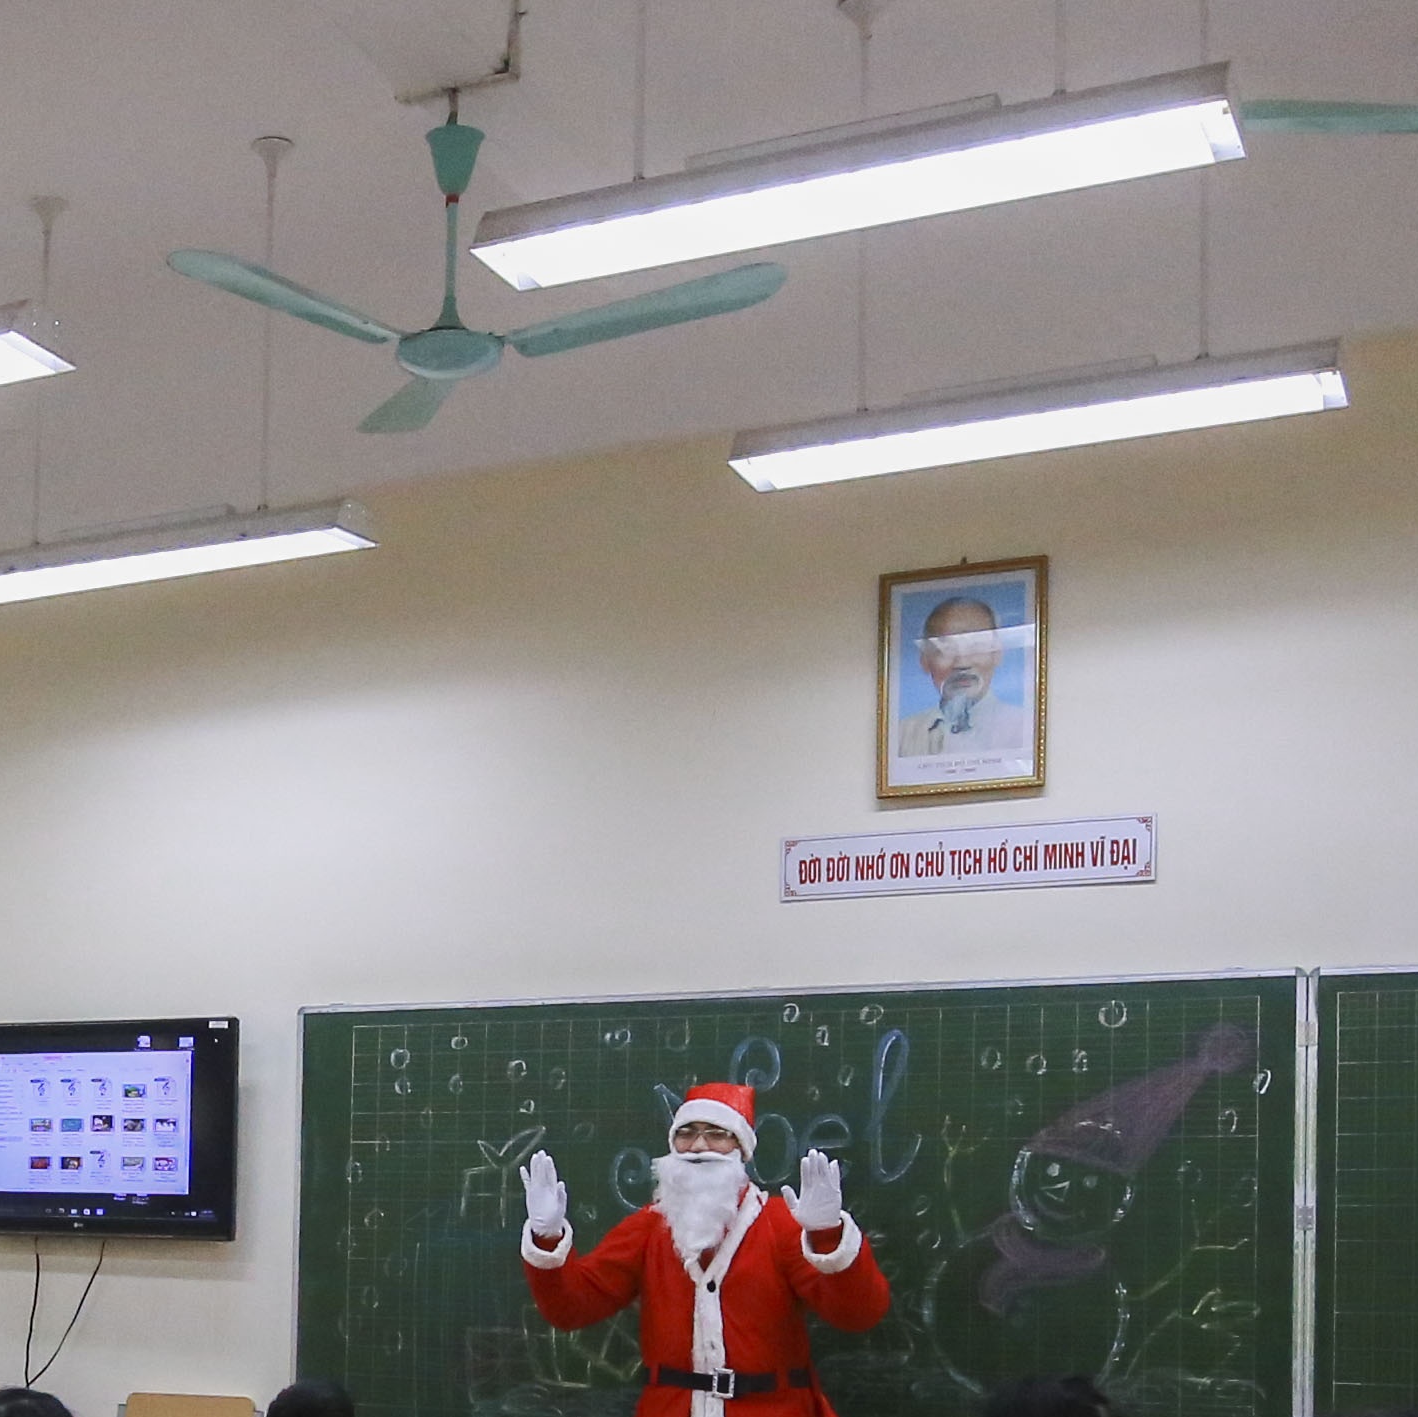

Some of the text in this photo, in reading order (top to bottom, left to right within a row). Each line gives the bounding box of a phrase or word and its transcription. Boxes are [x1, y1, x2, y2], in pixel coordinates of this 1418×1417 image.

[799, 853, 822, 884] ĐỜI
[826, 851, 850, 882] ĐỜI
[855, 848, 886, 881] NHỚ
[890, 851, 910, 879] ƠN
[915, 841, 945, 877] CHỦ
[949, 848, 982, 880] TỊCH
[1013, 840, 1039, 872] CHÍ
[1043, 841, 1085, 870] MINH
[1090, 836, 1106, 867] VĨ
[1110, 838, 1137, 870] ĐẠI
